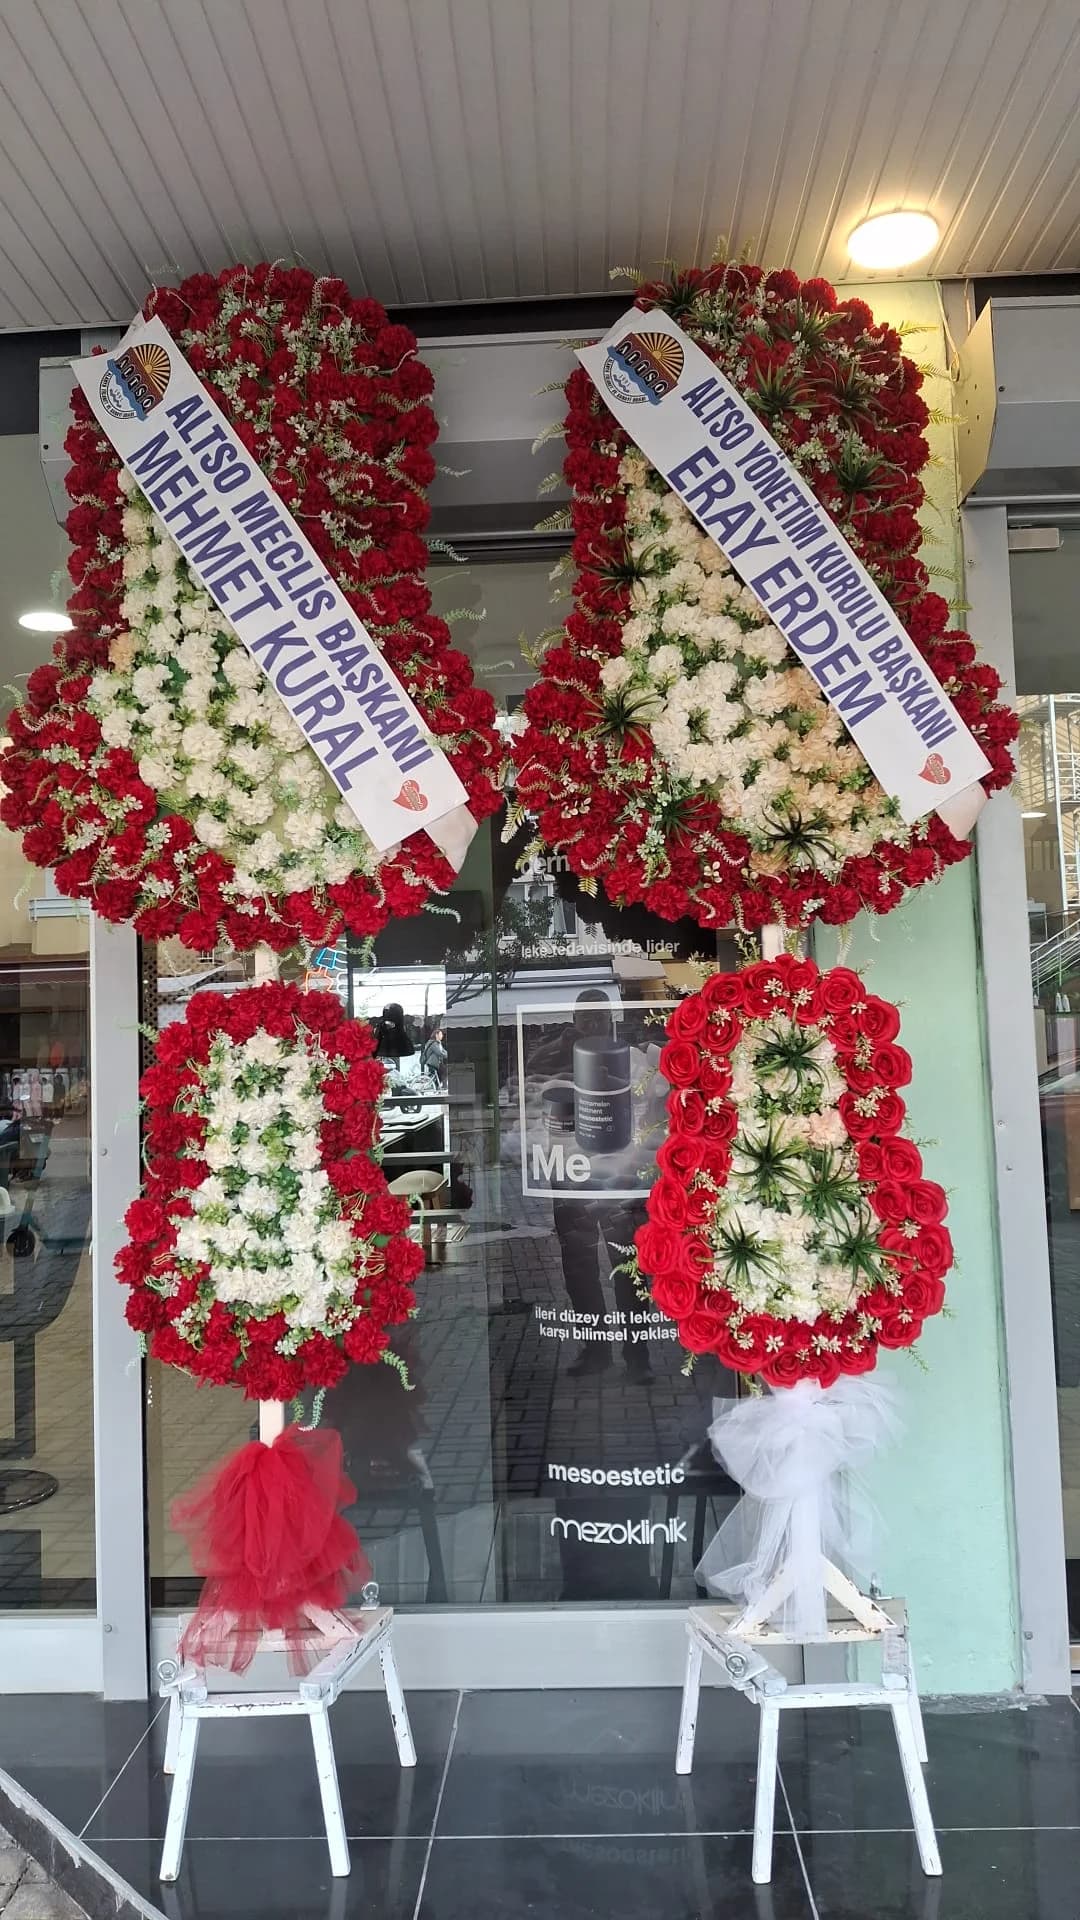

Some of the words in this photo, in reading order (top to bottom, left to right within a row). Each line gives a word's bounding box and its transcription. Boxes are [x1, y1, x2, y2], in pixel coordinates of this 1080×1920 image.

[116, 355, 155, 409] ALTSO
[617, 342, 667, 395] ALTSO
[165, 393, 252, 495] ALTSO
[231, 490, 337, 622] MECLİS
[316, 619, 434, 774] BAŞKANI
[667, 445, 780, 559] ERAY
[751, 556, 887, 727] ERDEM
[681, 376, 755, 450] ALTSO
[735, 439, 828, 551] YÖNETİM
[807, 541, 889, 642] KURULU
[869, 636, 957, 750] BAŞKANI
[127, 431, 282, 623] MEHMET
[251, 621, 380, 791] KURAL
[551, 938, 642, 957] tedavisinde
[646, 939, 681, 953] lider
[532, 1143, 591, 1183] Me
[535, 1306, 556, 1321] ileri
[559, 1310, 600, 1326] düzey
[603, 1311, 627, 1325] cilt
[539, 1323, 569, 1342] karşı
[573, 1327, 628, 1342] bilimsel
[548, 1463, 685, 1486] mesoestetic
[550, 1516, 688, 1545] mezoklinik
